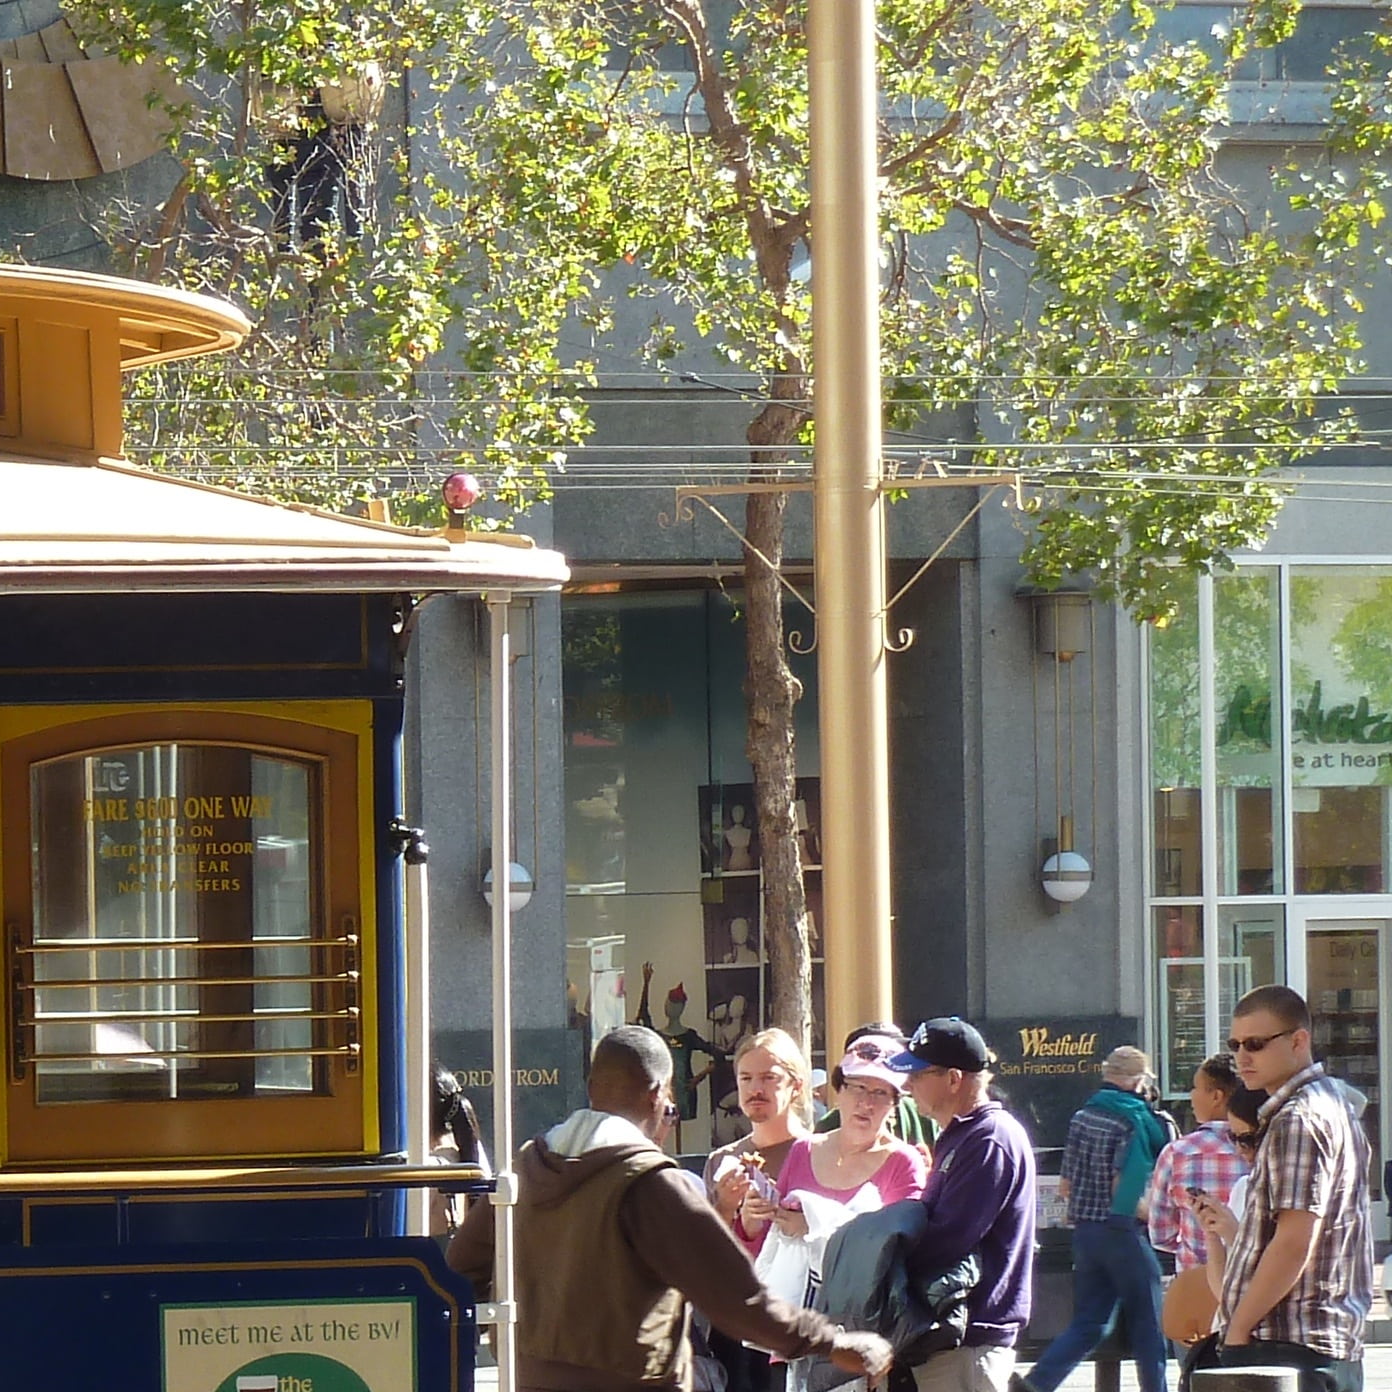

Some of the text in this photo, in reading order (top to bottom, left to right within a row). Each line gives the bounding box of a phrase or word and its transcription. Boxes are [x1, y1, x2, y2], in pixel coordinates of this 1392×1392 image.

[1311, 753, 1334, 768] at
[83, 799, 129, 821] FARE
[184, 797, 225, 819] ONE
[230, 796, 273, 818] WAY
[190, 825, 214, 838] ON
[205, 842, 254, 855] FLOOR
[1019, 1027, 1097, 1057] Westfield
[1000, 1062, 1020, 1075] San
[1023, 1061, 1075, 1075] Francisco
[454, 1068, 559, 1087] ORDROM
[247, 1324, 284, 1344] me
[290, 1320, 315, 1343] at
[320, 1318, 360, 1342] the
